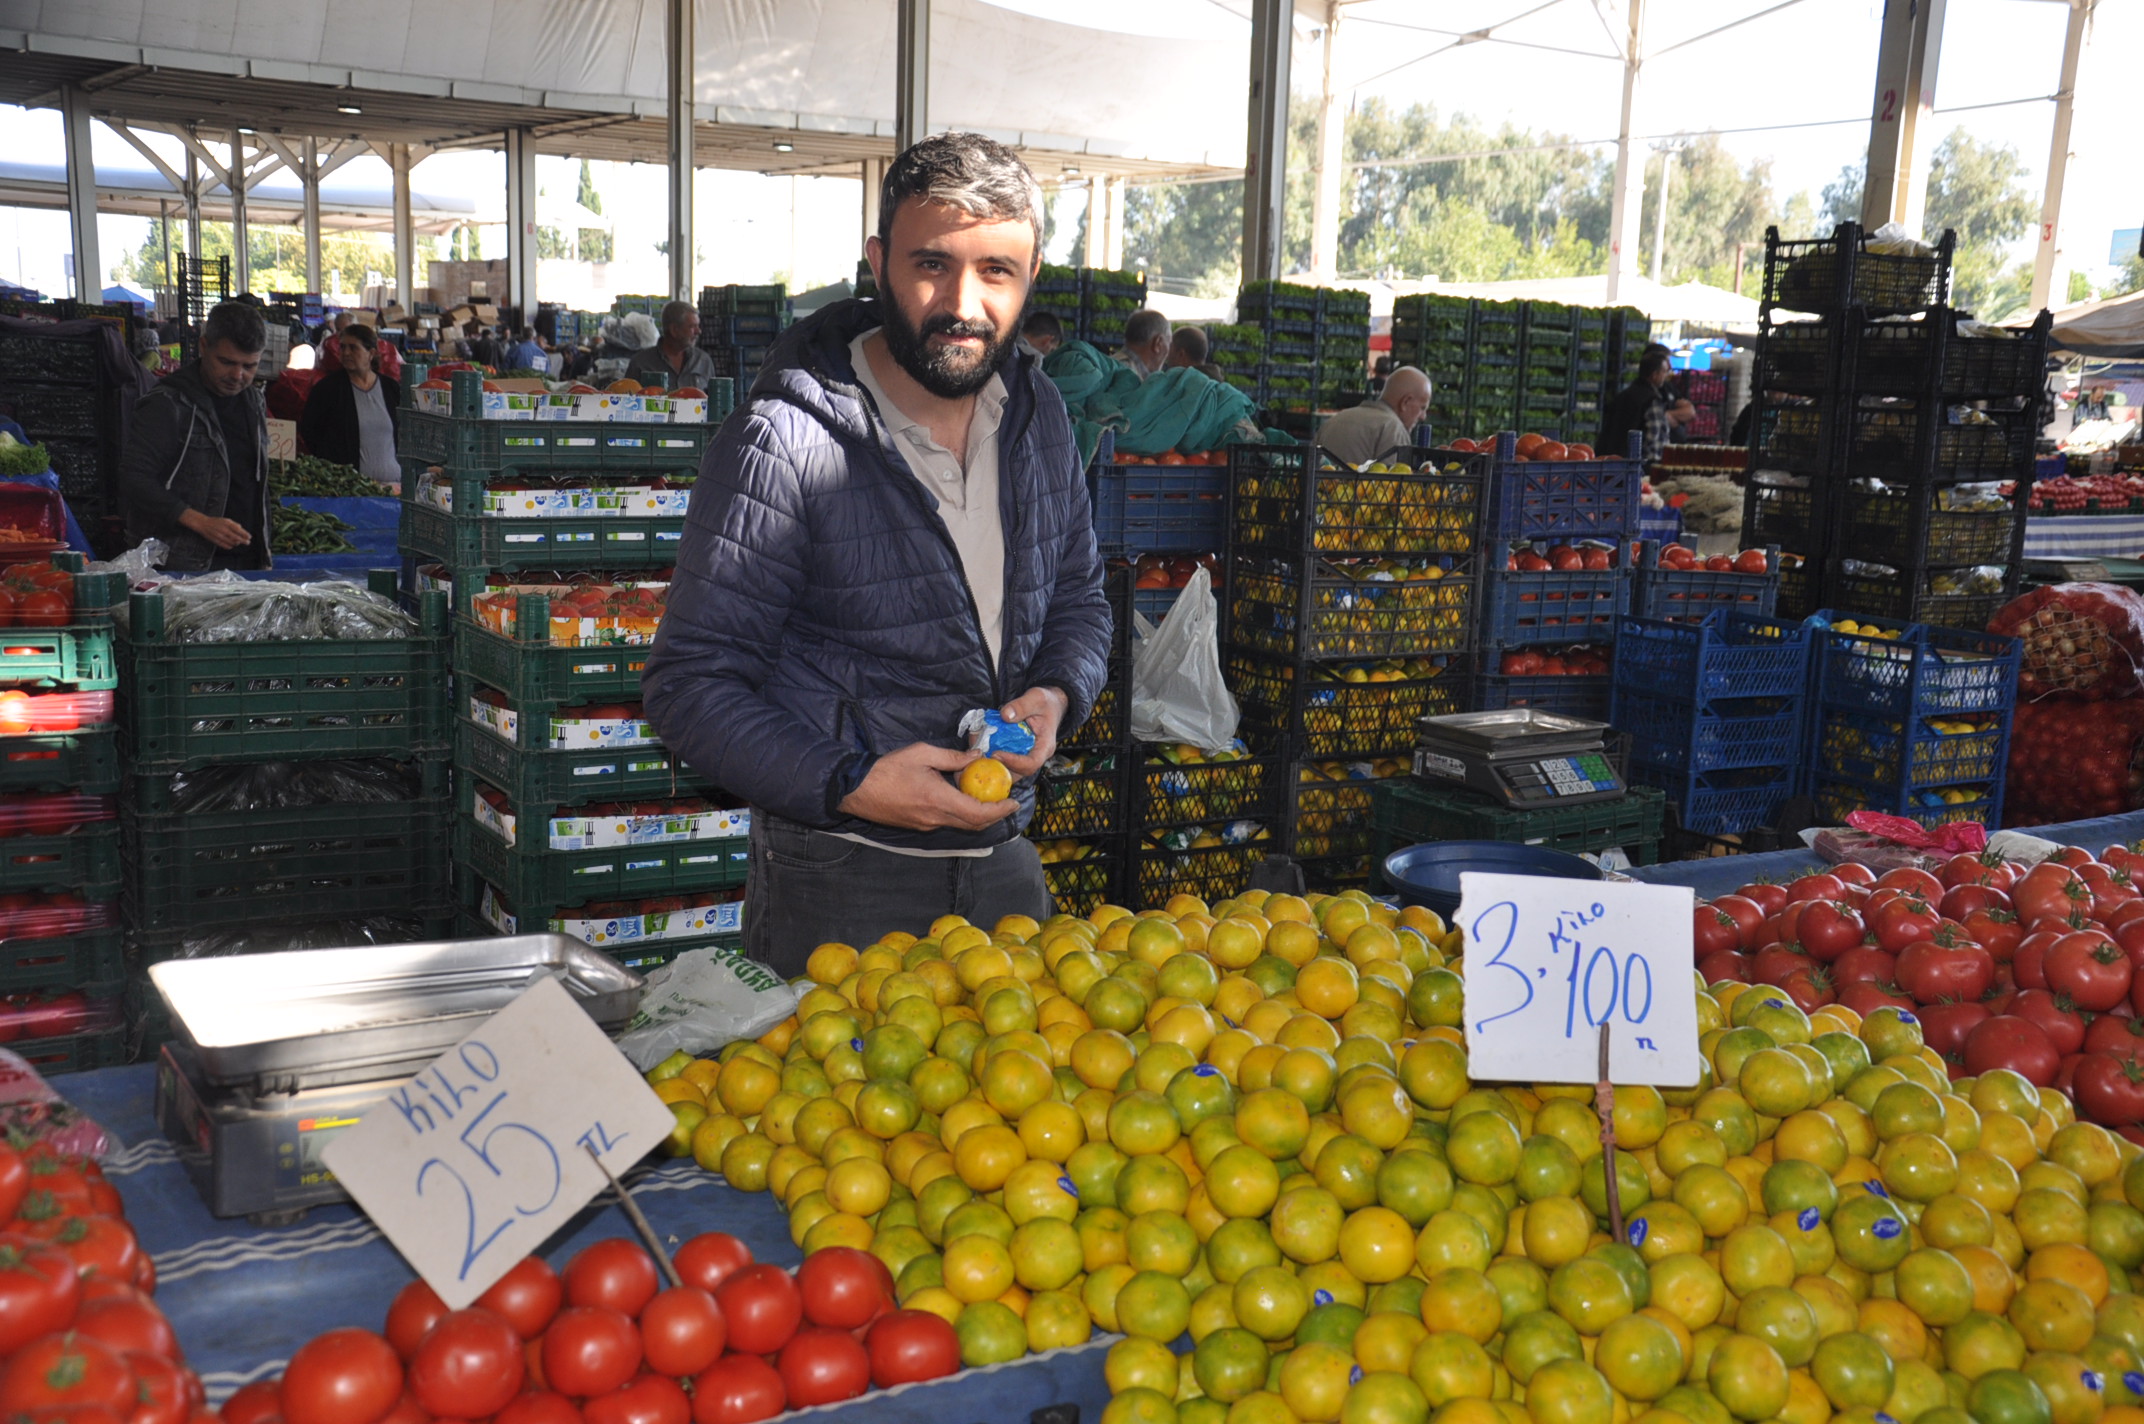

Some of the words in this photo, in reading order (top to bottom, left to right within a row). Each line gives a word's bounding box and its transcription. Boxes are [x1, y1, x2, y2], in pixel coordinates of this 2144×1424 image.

[1881, 88, 1896, 122] 2
[2042, 223, 2053, 242] 3
[576, 1120, 630, 1157] TL
[417, 1090, 561, 1281] 25
